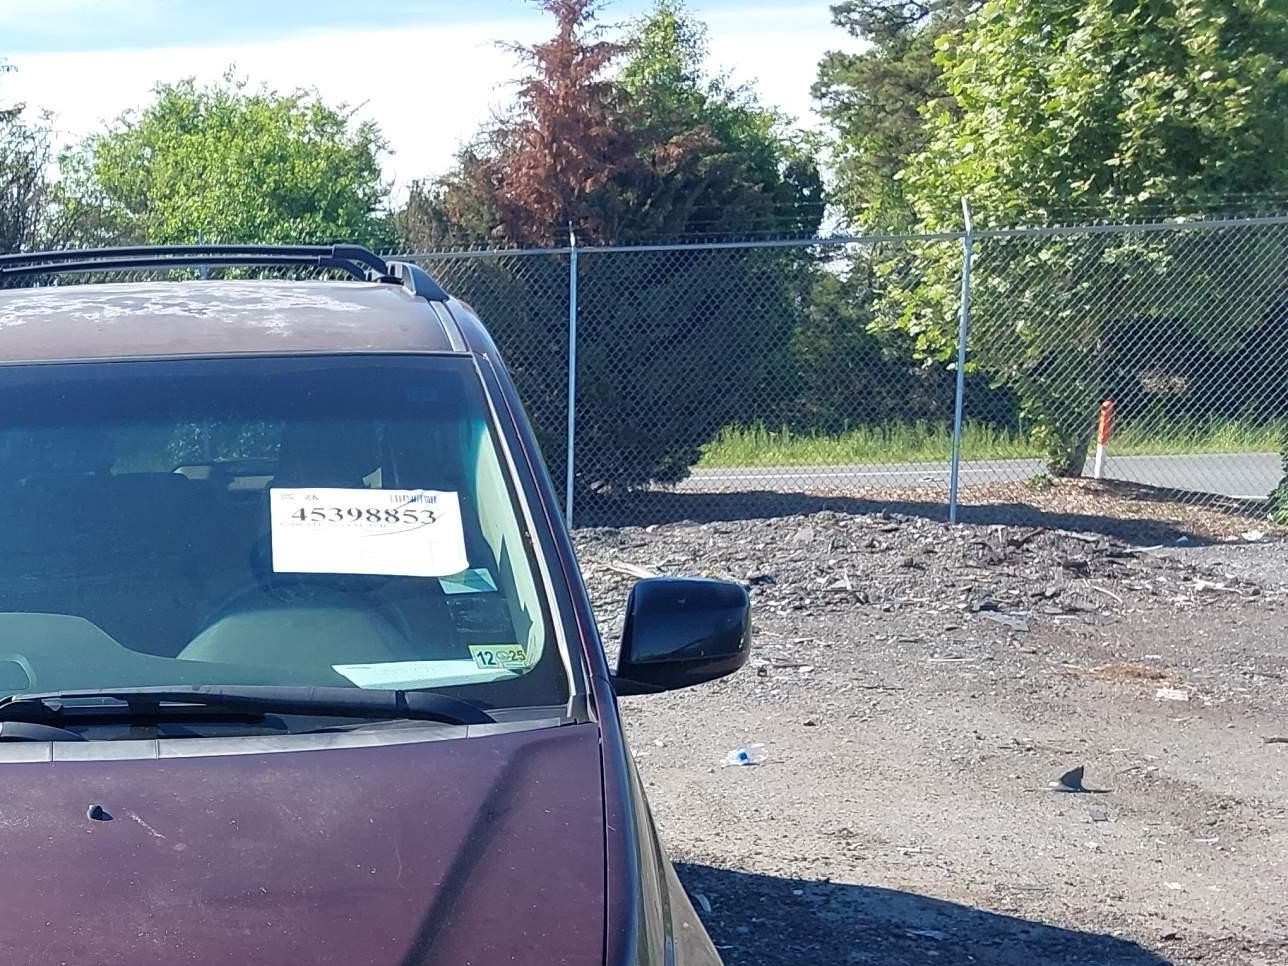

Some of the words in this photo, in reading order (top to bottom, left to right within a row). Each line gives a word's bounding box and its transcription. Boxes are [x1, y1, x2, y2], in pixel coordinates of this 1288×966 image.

[291, 507, 437, 525] 45398853
[477, 651, 497, 665] 12
[509, 650, 526, 661] 25
